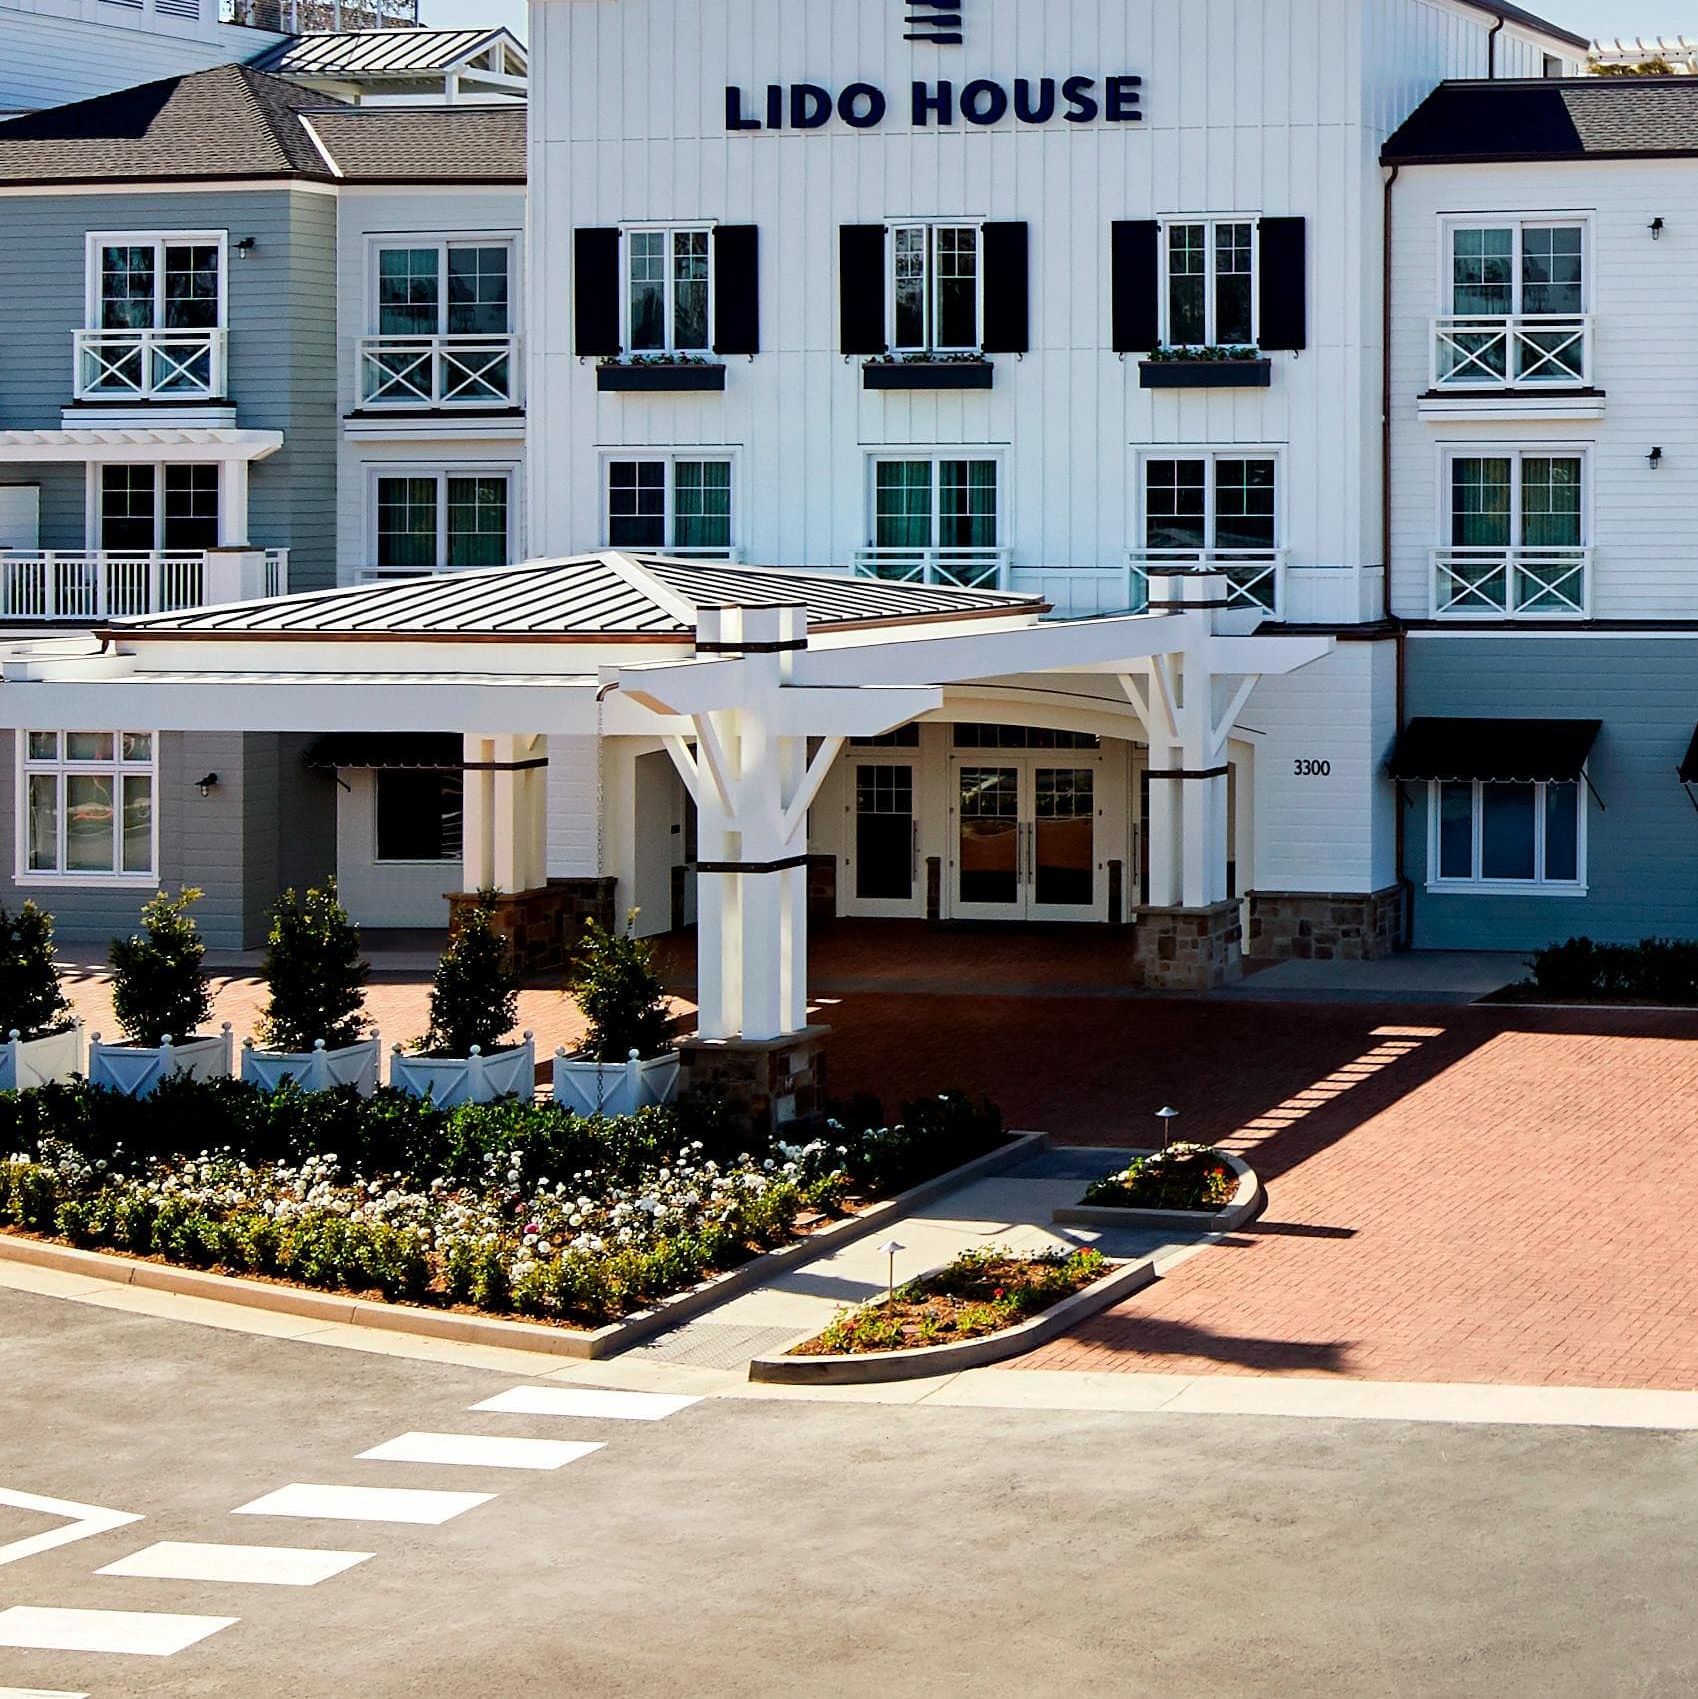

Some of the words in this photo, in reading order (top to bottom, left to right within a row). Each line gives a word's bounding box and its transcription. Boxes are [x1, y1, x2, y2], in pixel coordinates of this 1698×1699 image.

[725, 82, 886, 132] LIDO
[911, 75, 1143, 127] HOUSE
[1293, 758, 1331, 777] 3300
